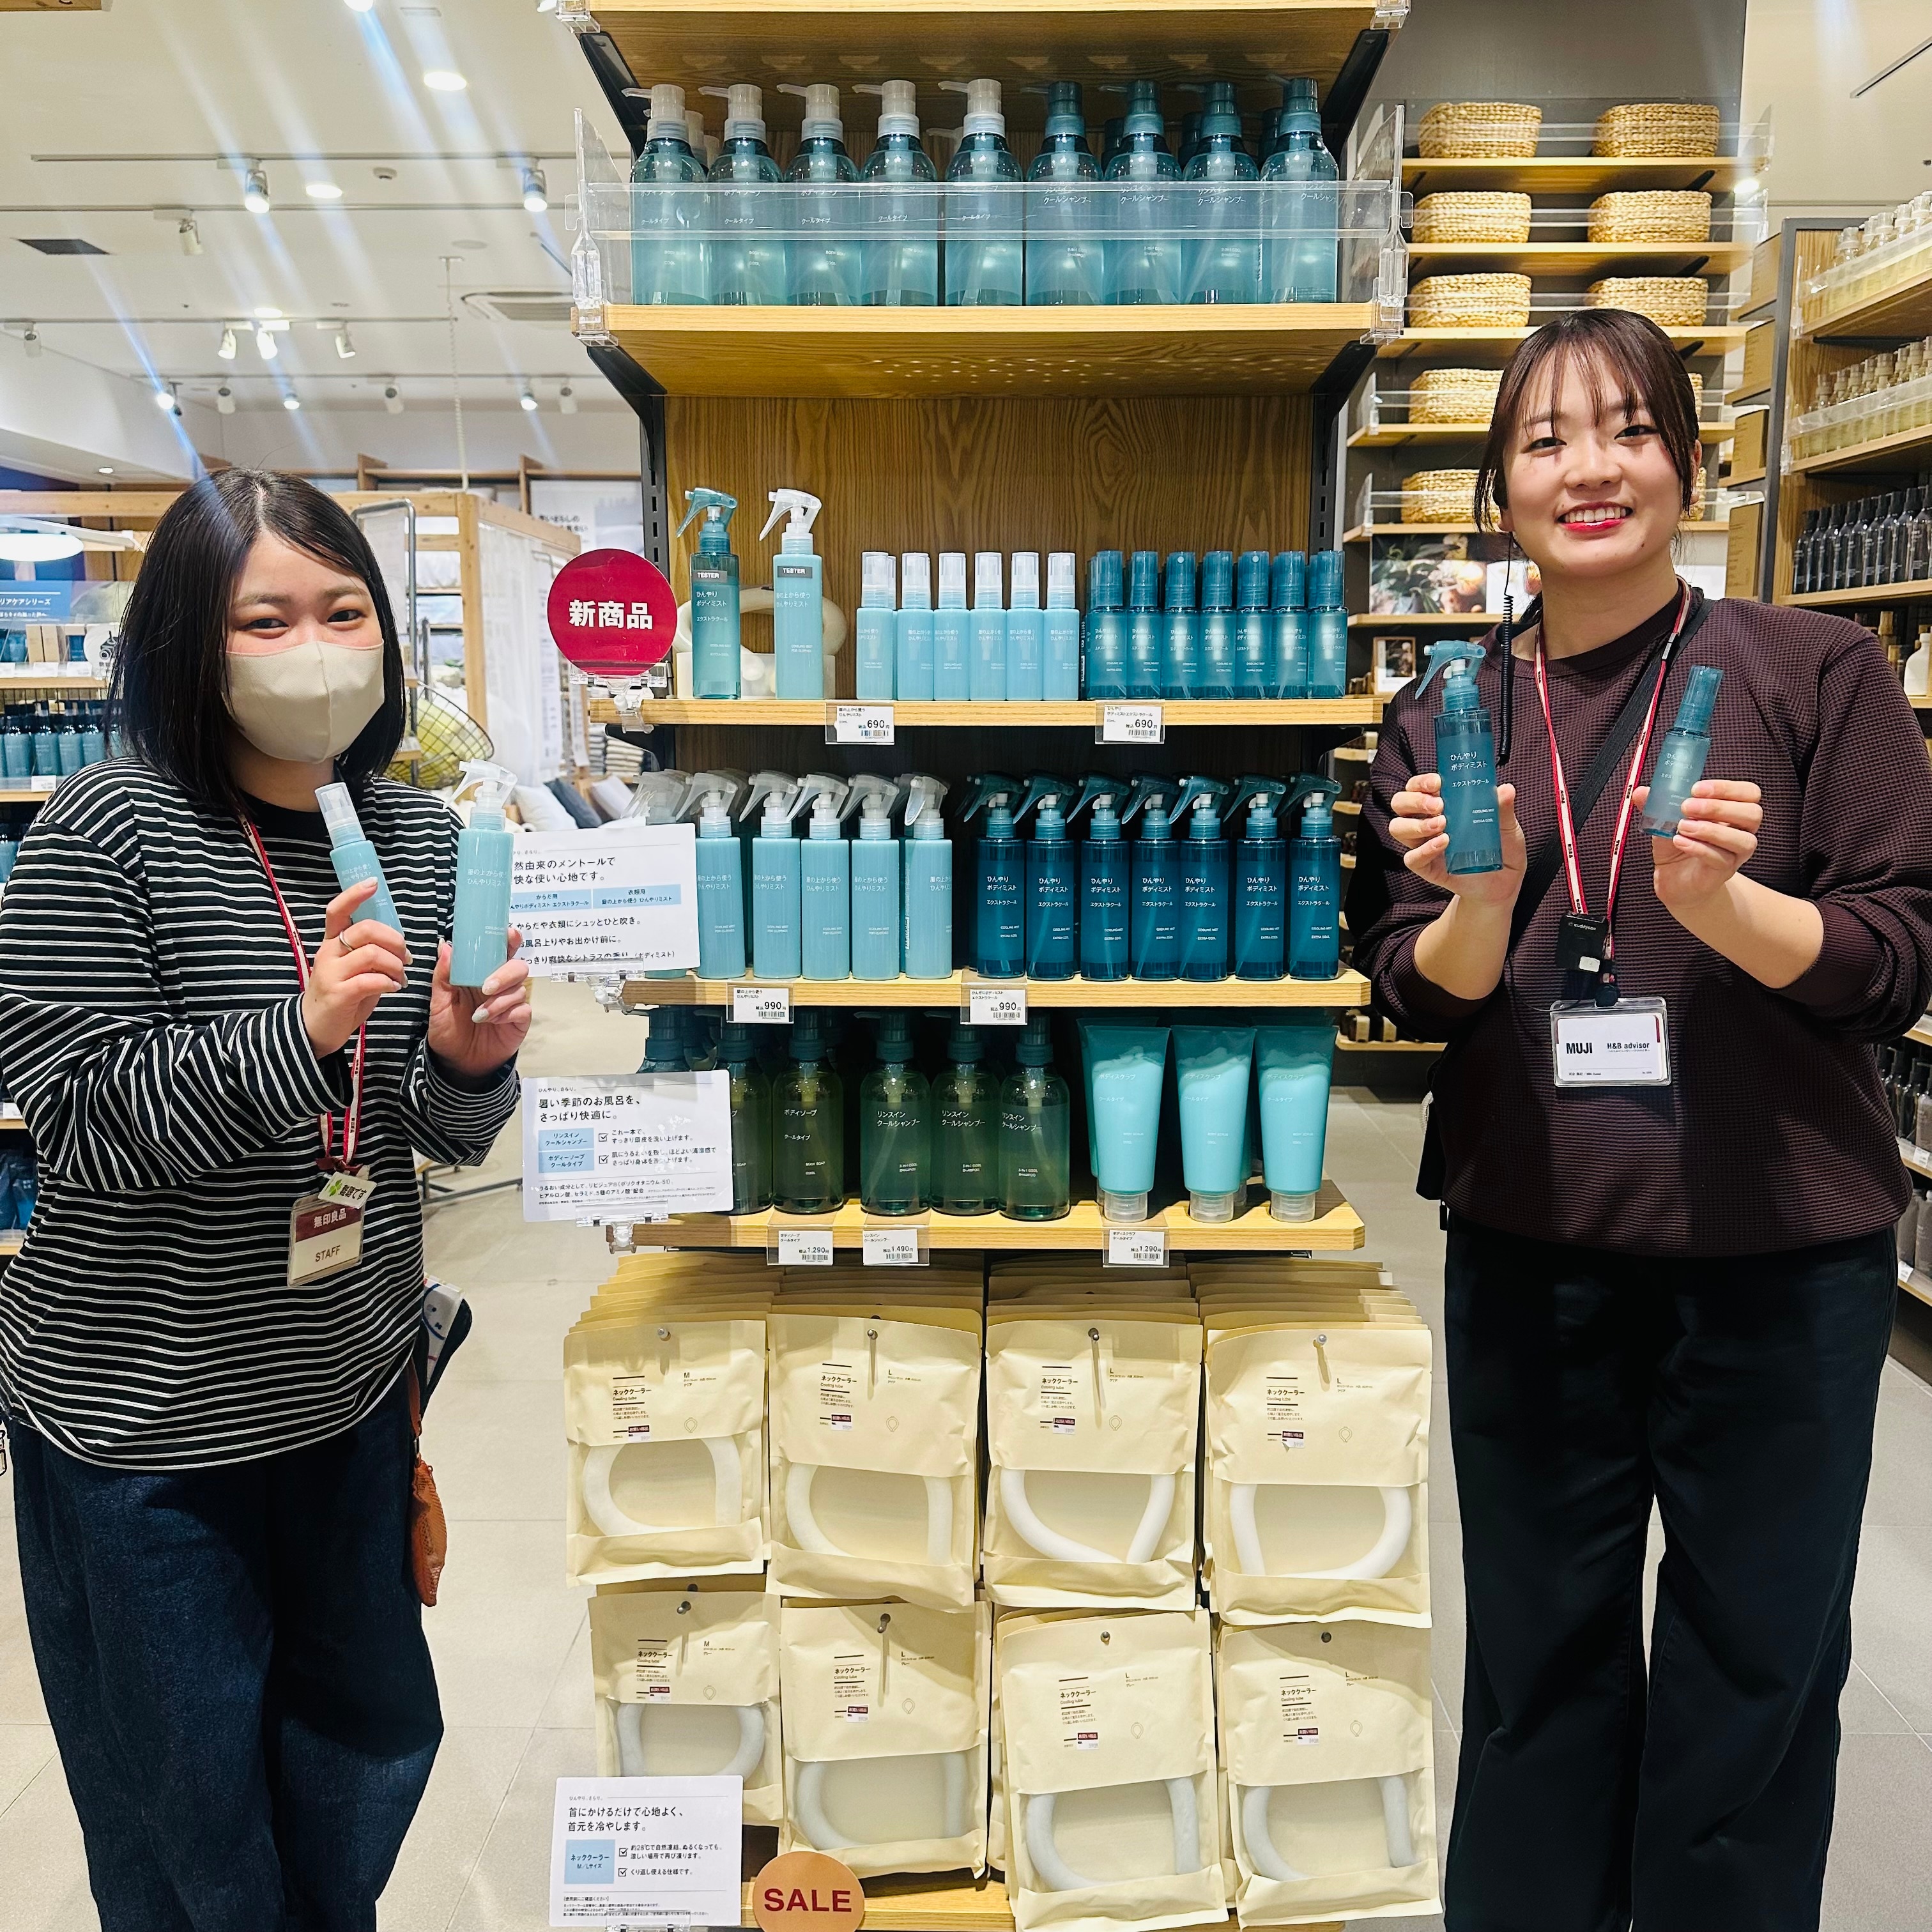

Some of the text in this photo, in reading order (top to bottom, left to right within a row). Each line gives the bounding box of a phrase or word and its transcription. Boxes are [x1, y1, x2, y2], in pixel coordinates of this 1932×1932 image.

[1043, 195, 1092, 204] クールシャンプー
[1121, 194, 1170, 204] クールシャンプー
[1198, 196, 1246, 206] クールシャンプー
[569, 599, 653, 629] 新商品
[1450, 751, 1477, 761] ひんやり
[1451, 760, 1488, 771] ボディミスト
[1452, 779, 1490, 788] エクストラクール
[514, 857, 616, 871] 然由来のメントールで
[467, 878, 506, 887] ひんやりミスト
[511, 871, 605, 885] 快な使い心地です。
[1247, 876, 1270, 884] ひんやり
[1298, 875, 1321, 884] ひんやり
[516, 916, 641, 930] からだや衣類にシュッとひと吹き。
[1566, 1042, 1593, 1054] MUJI
[539, 1094, 641, 1110] 暑い季節のお風呂を、
[540, 1110, 618, 1123] さっぱり快適に。
[1002, 1112, 1025, 1122] リンスイン
[877, 1118, 921, 1127] クールシャンプー
[941, 1119, 986, 1127] クールシャンプー
[1002, 1121, 1043, 1131] クールシャンプー
[314, 1208, 347, 1229] 無印良品
[315, 1245, 341, 1262] STAFF
[1060, 1690, 1096, 1698] ネッククーラー
[569, 1807, 684, 1818] 首にかけるだけで心地よく、
[568, 1821, 647, 1832] 首元を冷やします。
[764, 1889, 852, 1913] SALE
